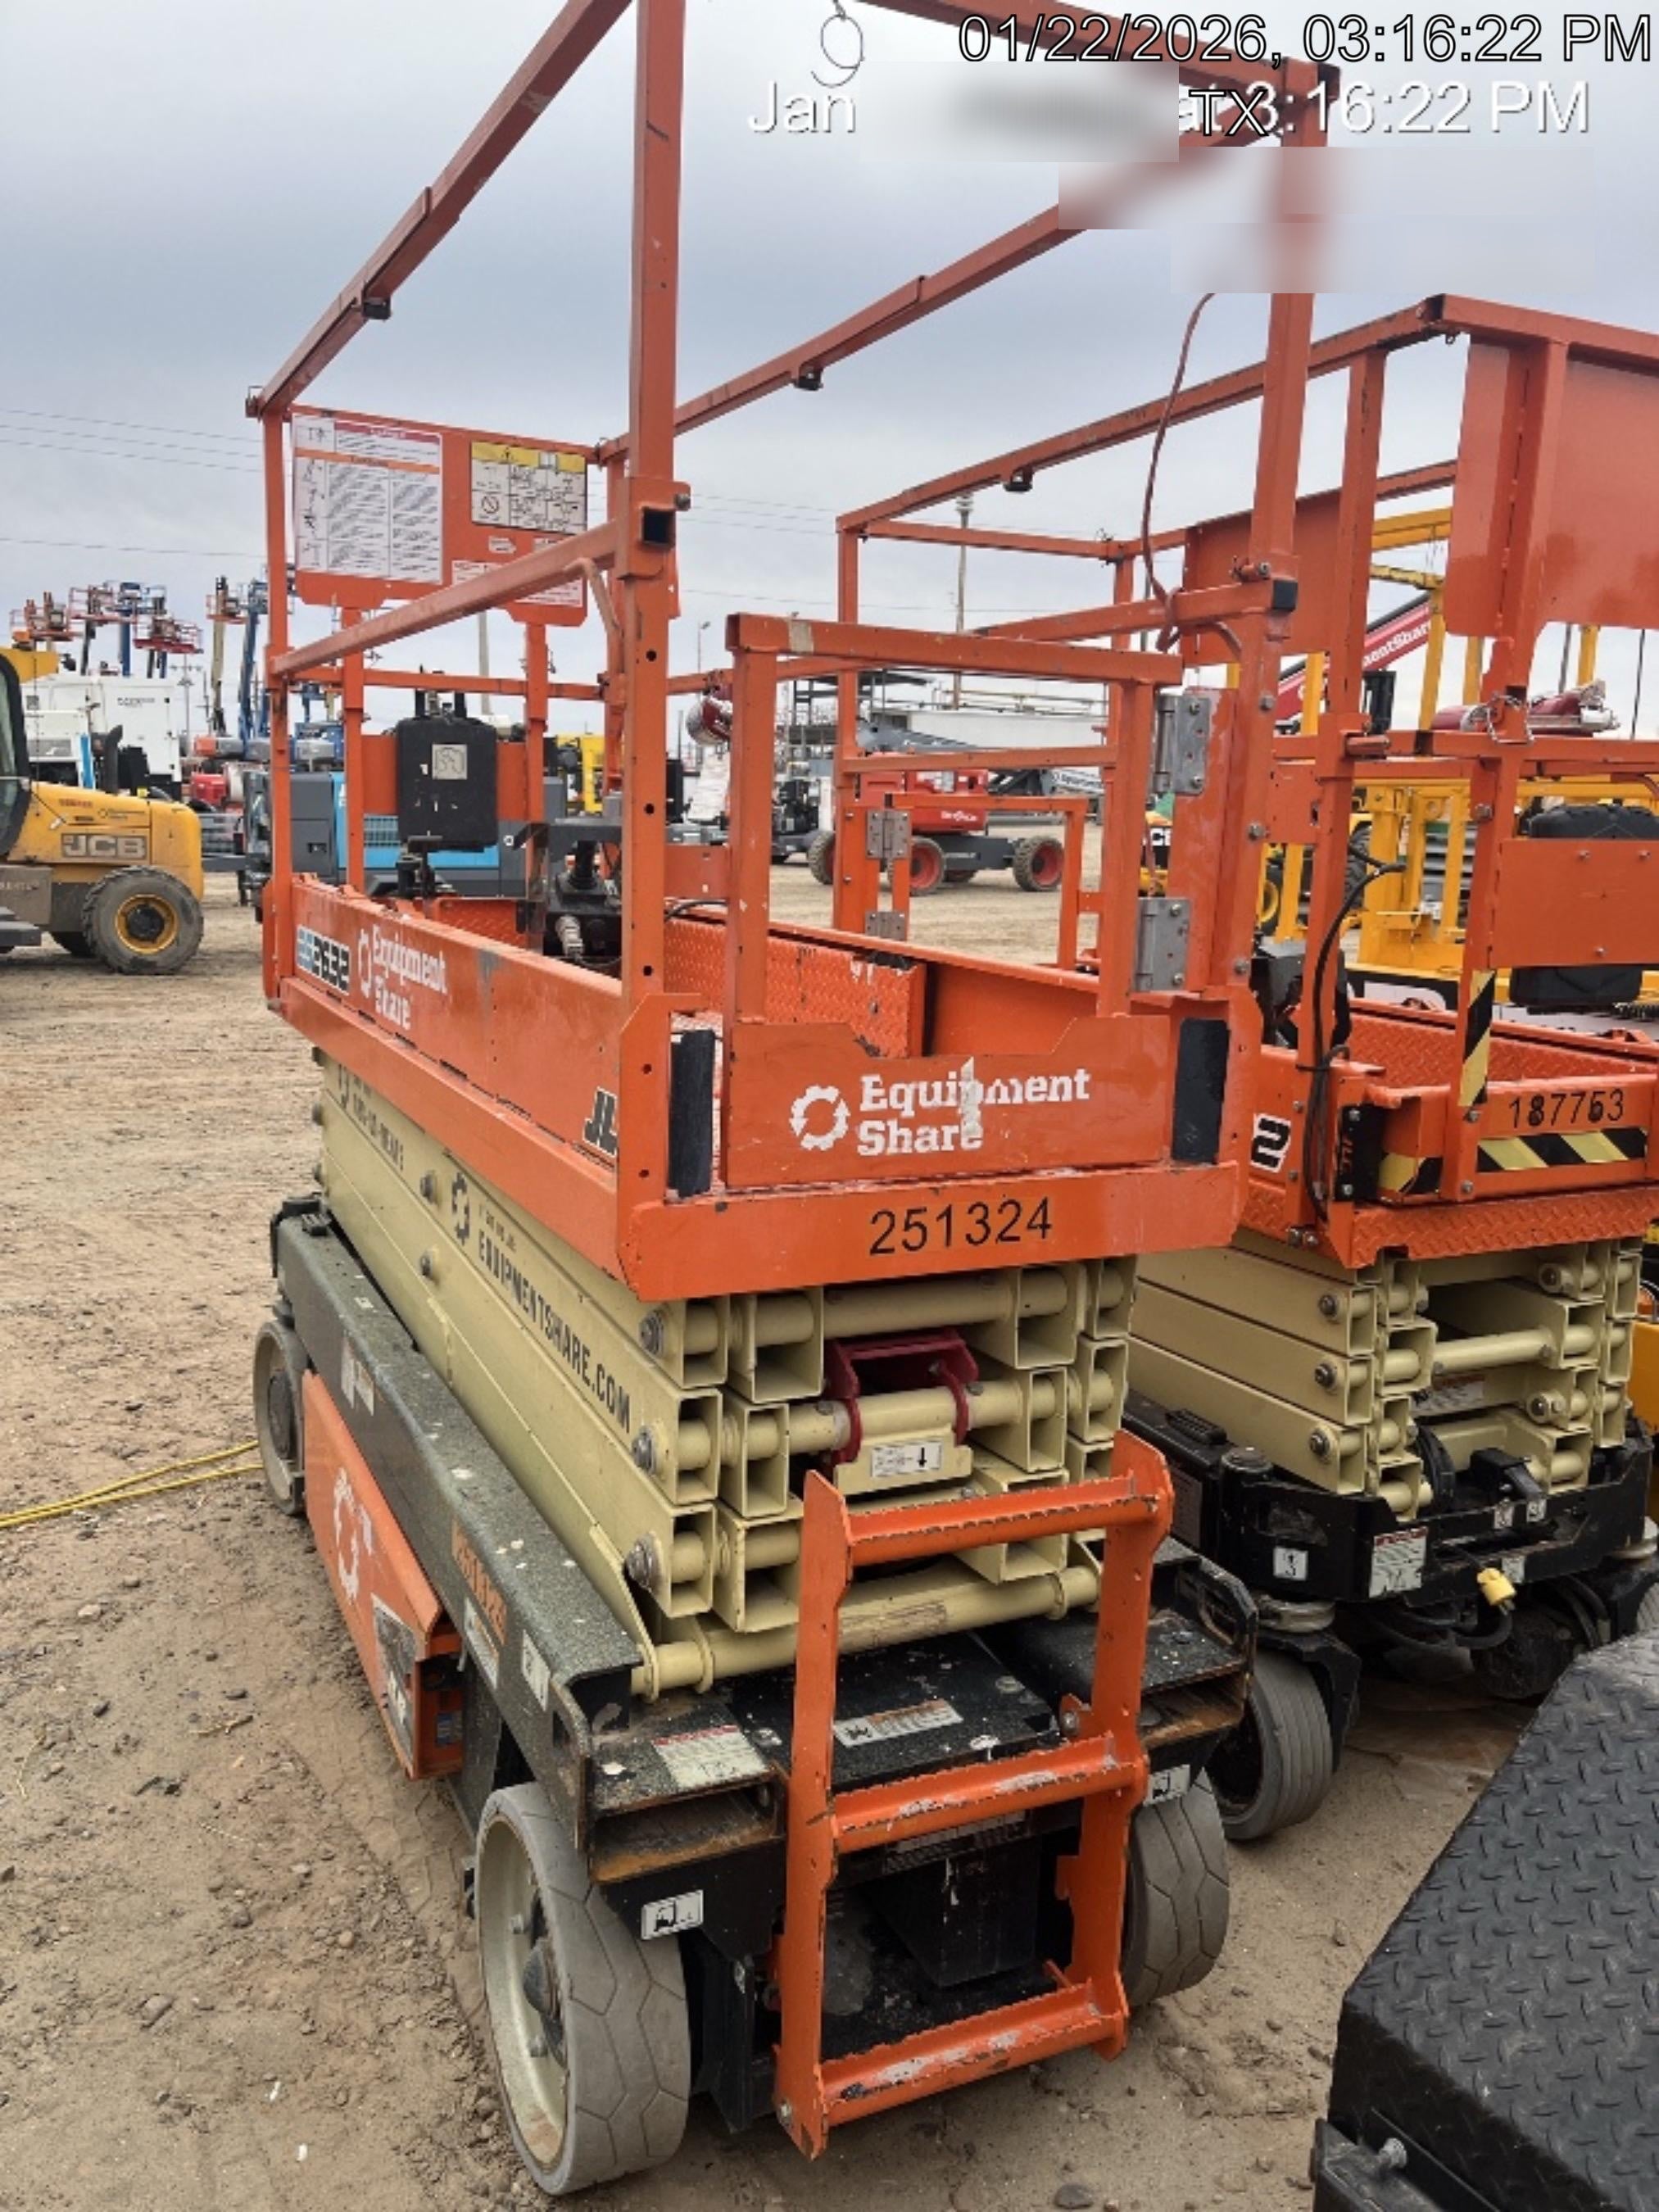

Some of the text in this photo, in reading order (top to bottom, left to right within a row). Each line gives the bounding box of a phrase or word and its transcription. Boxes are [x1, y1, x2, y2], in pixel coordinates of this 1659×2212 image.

[62, 834, 146, 859] JCB
[373, 924, 448, 995] Equipment
[859, 1067, 1091, 1117] Equipment
[582, 1086, 619, 1158] JL
[857, 1118, 983, 1156] Share
[870, 1196, 1052, 1256] 251324
